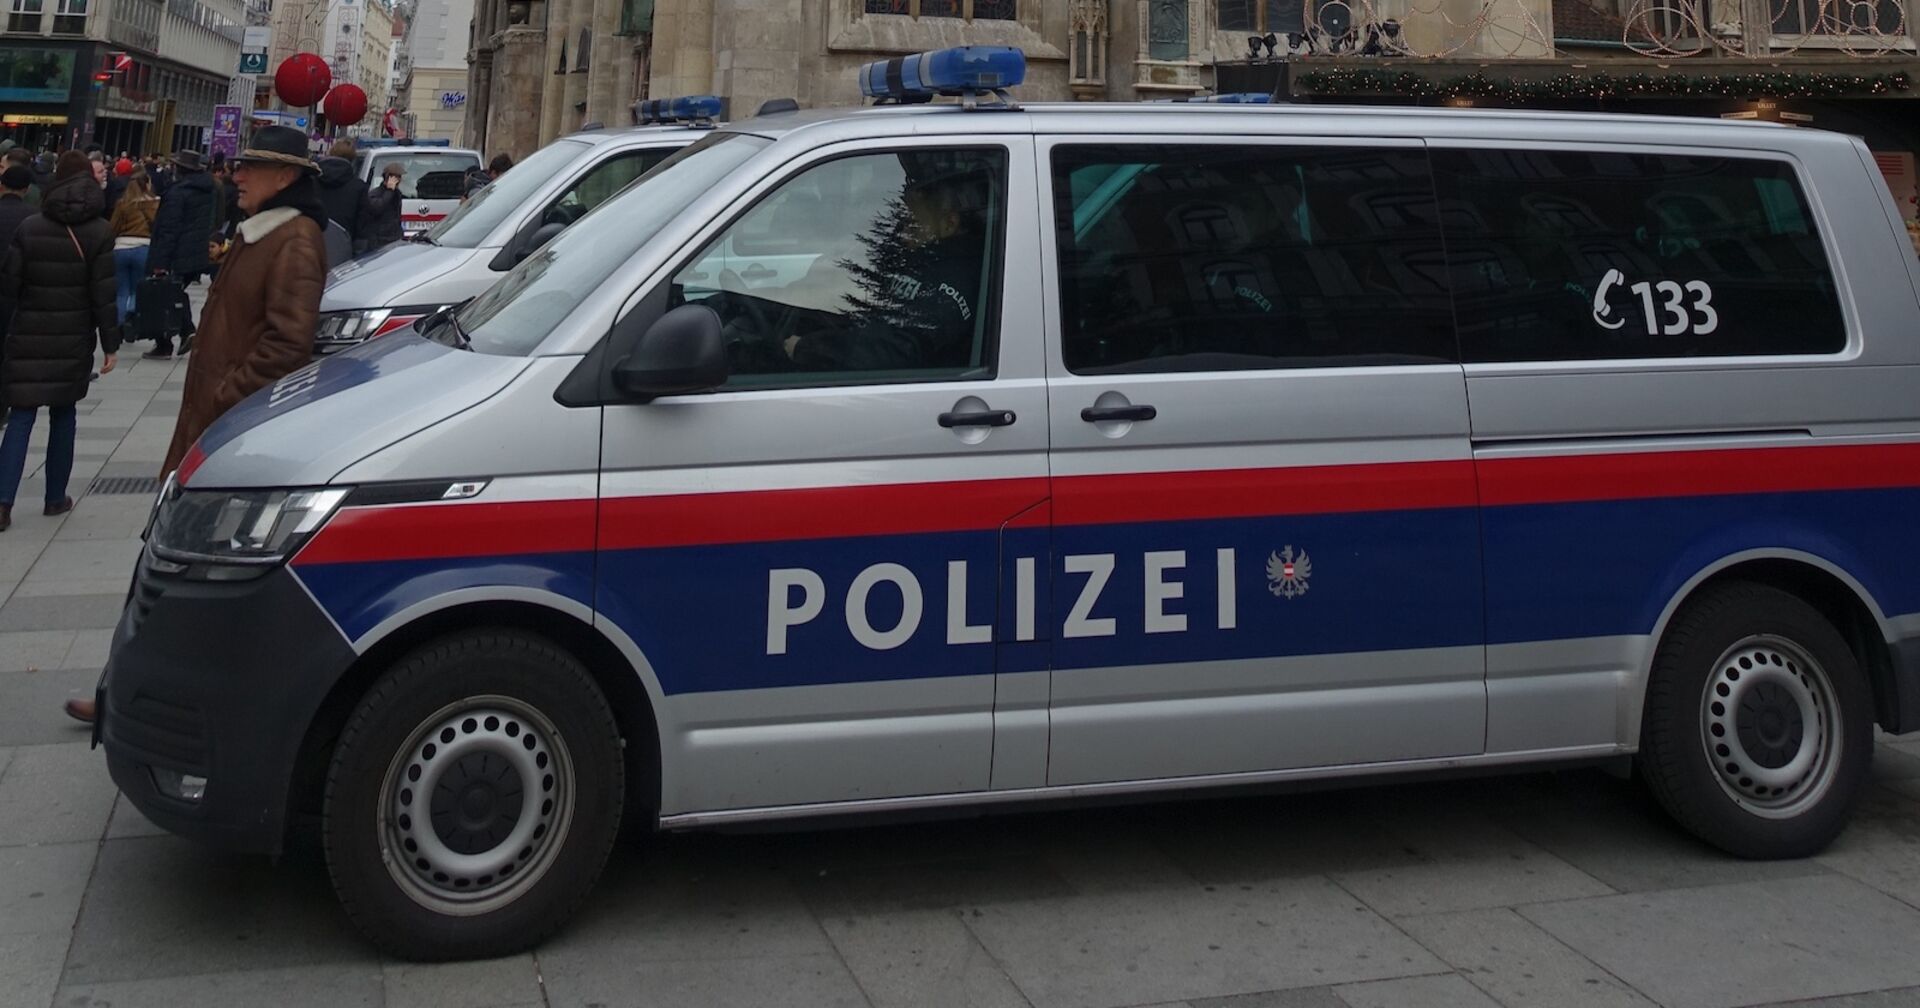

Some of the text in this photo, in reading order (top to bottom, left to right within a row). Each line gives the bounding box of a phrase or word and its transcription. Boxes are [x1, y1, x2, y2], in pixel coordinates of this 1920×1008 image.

[938, 282, 972, 321] POLIZEI
[1232, 286, 1273, 313] POLIZEI
[1630, 279, 1719, 336] 133
[766, 547, 1237, 656] POLIZEI
